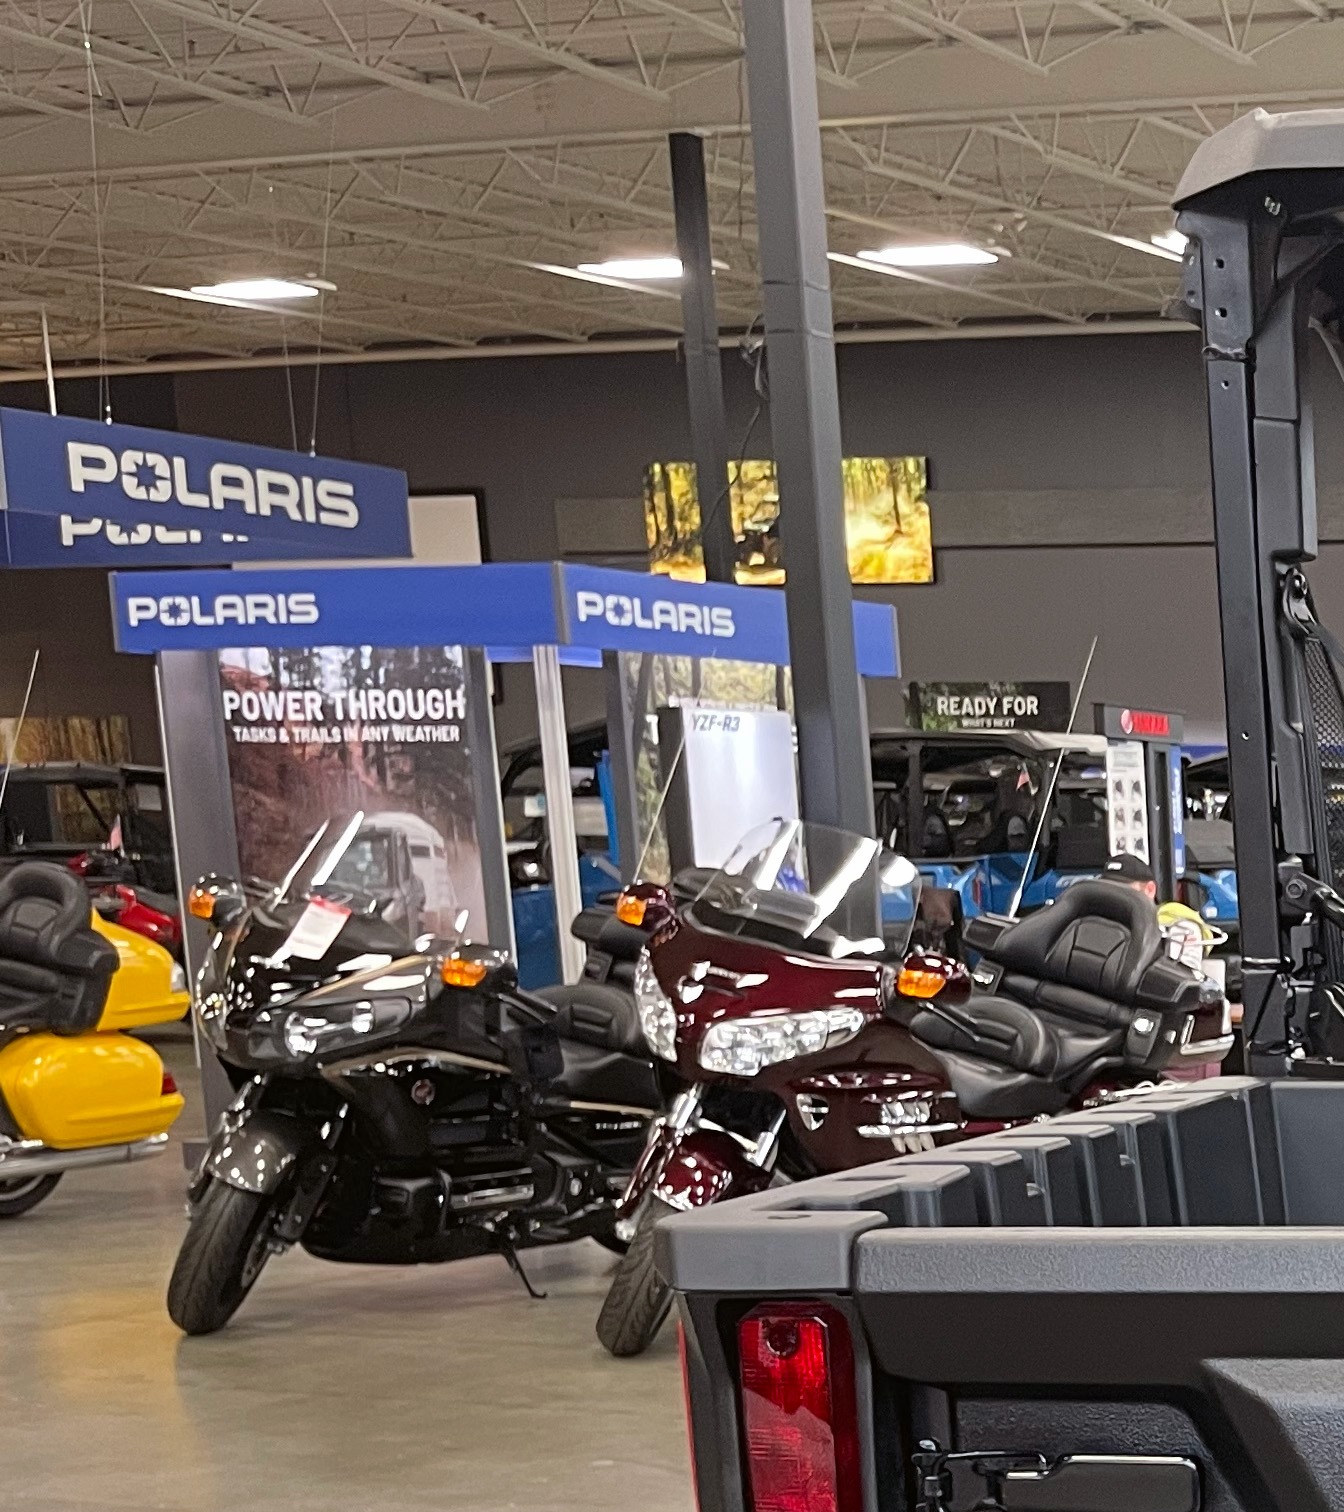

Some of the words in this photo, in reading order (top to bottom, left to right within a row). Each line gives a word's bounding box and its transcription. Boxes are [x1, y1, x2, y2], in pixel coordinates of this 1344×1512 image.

[67, 441, 359, 529] POLARIS
[127, 592, 320, 627] POLARIS
[577, 591, 736, 638] POLARIS
[222, 689, 324, 721] POWER
[333, 689, 466, 721] THROUGH
[936, 696, 998, 716] READY
[1002, 696, 1039, 716] FOR
[232, 726, 277, 743] TASKS
[291, 725, 342, 743] TRAILS
[361, 725, 390, 742] ANY
[391, 725, 461, 742] WEATHER
[691, 714, 740, 731] YZF-R3
